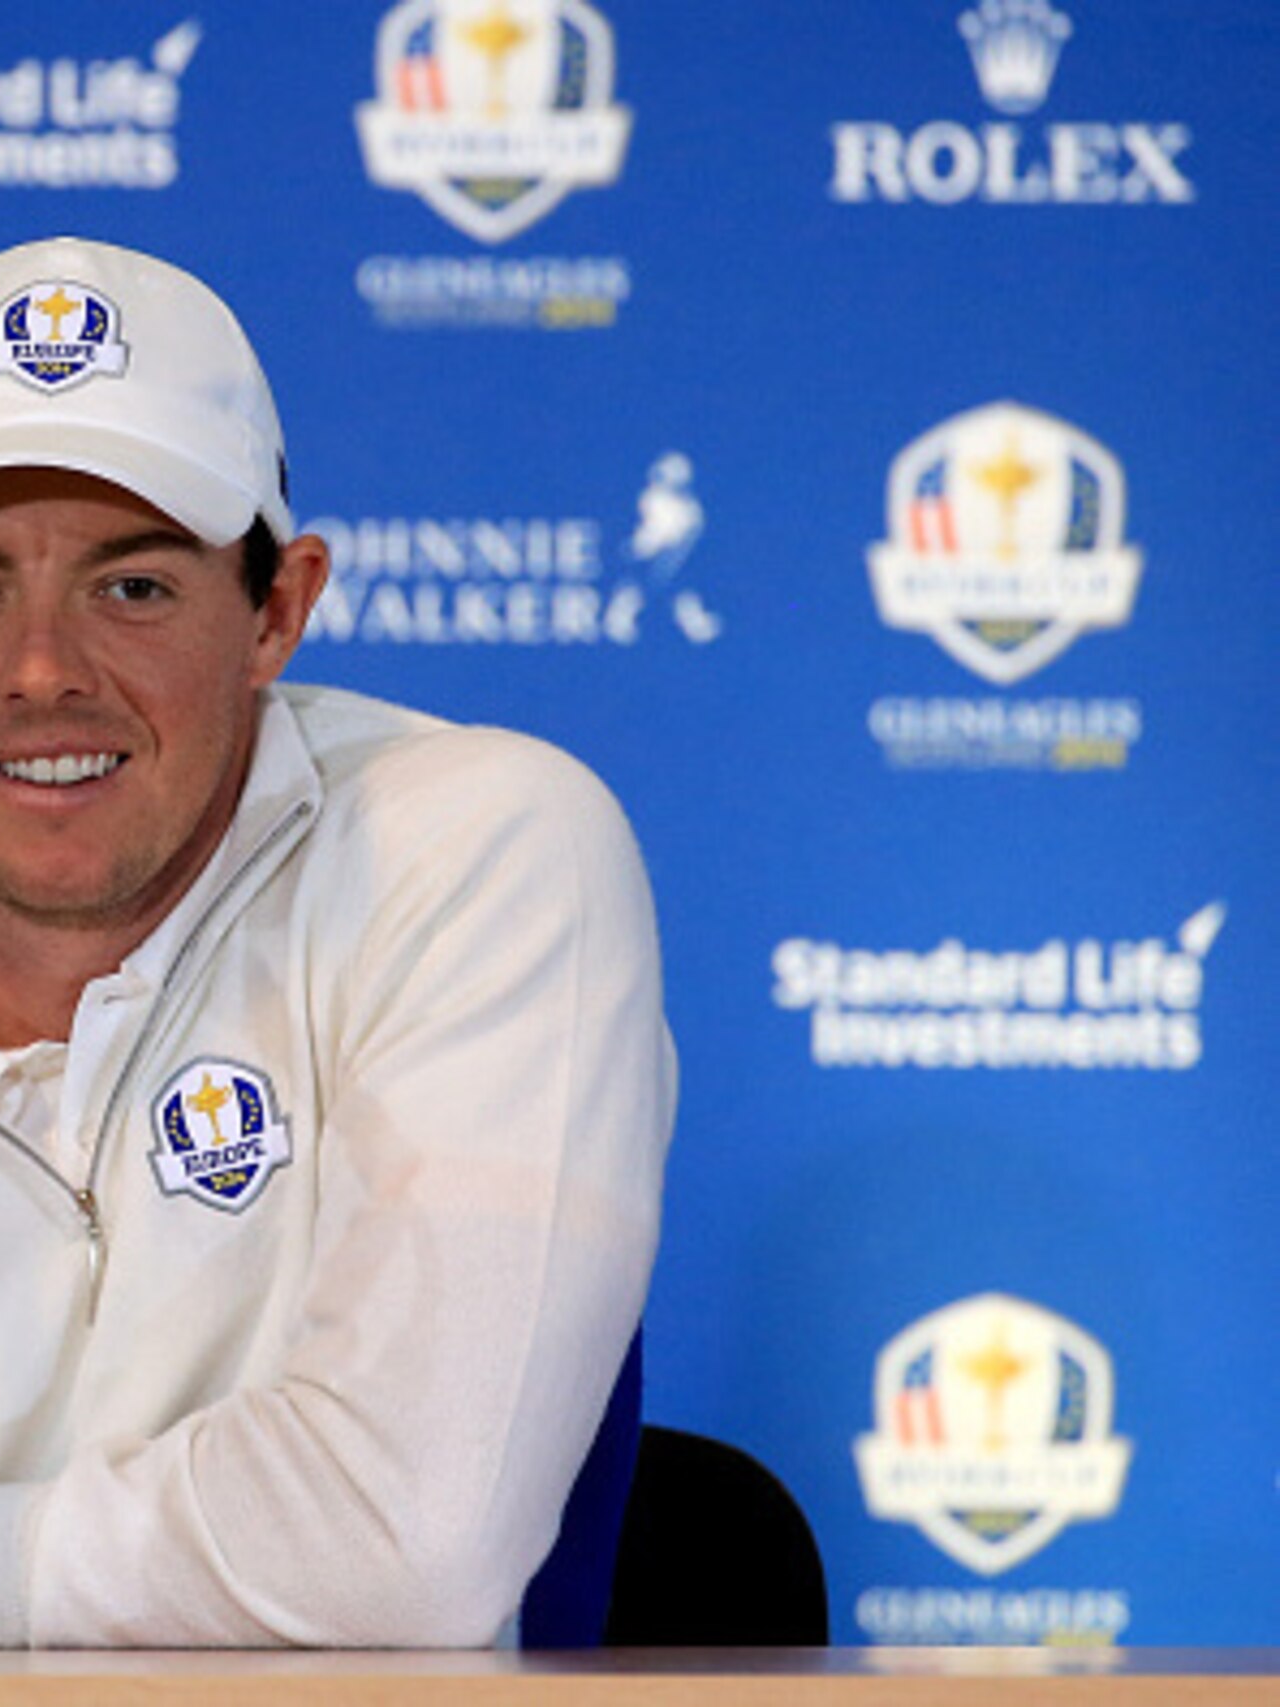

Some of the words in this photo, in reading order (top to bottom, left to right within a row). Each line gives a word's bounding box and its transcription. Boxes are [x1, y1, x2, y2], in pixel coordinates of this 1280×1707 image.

[51, 59, 179, 128] Life
[830, 121, 1196, 203] ROLEX
[300, 516, 602, 579] OHNNIE
[771, 937, 1068, 1010] Standard
[1074, 937, 1204, 1009] Life
[811, 1003, 1202, 1069] Investments
